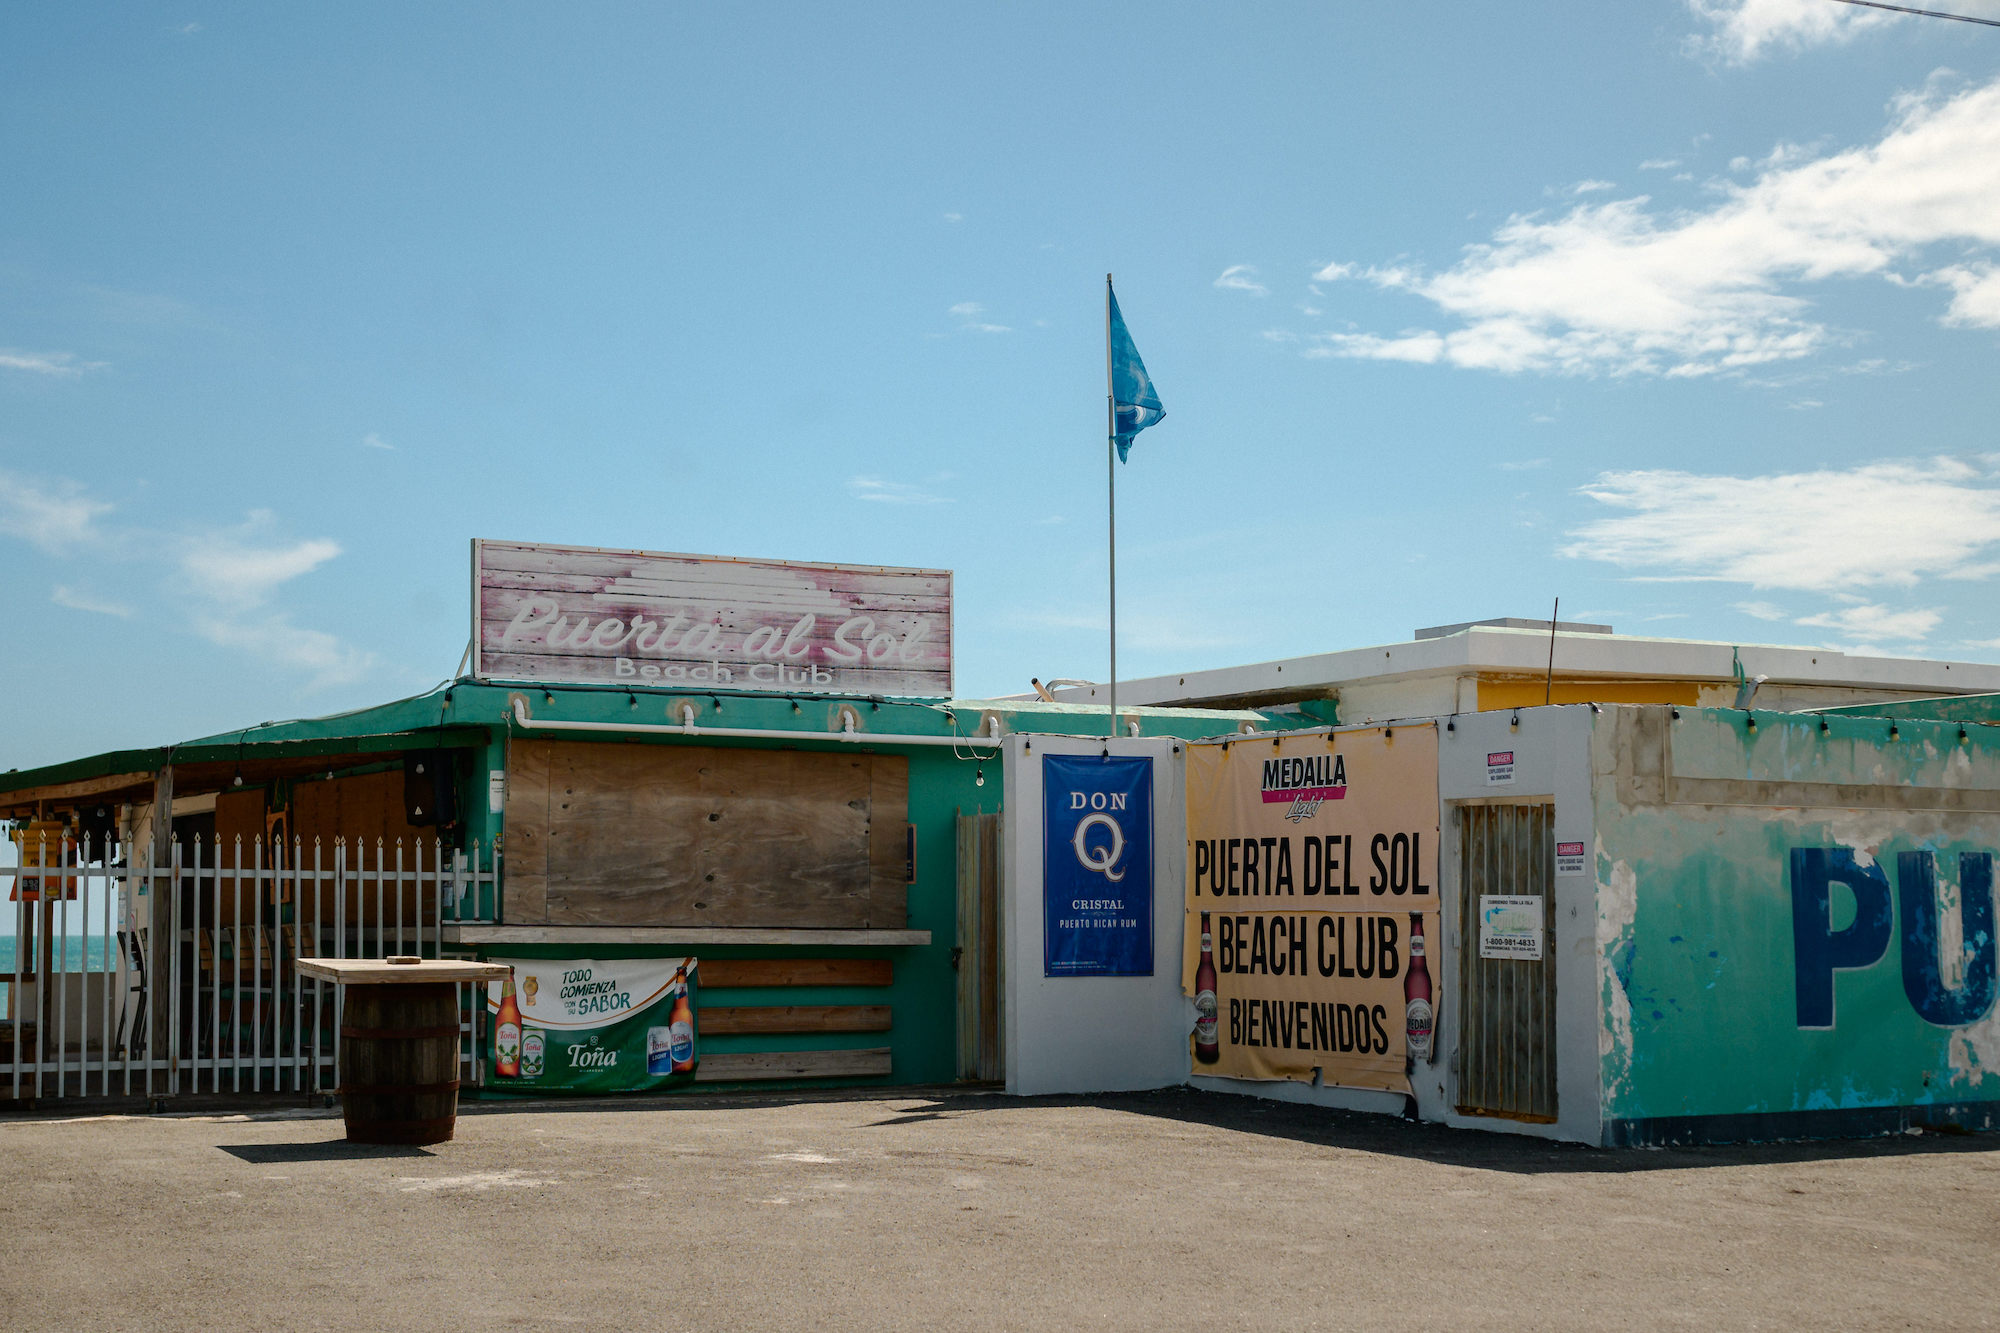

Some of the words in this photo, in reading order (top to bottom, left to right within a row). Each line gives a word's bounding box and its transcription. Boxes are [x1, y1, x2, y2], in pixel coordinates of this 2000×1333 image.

[500, 597, 726, 656] Puerta
[743, 613, 816, 657] al
[822, 615, 931, 664] Sol
[616, 657, 732, 682] Beach
[749, 662, 834, 685] Club
[1490, 754, 1511, 763] DANGER
[1261, 753, 1348, 791] MEDALLA
[1070, 792, 1128, 810] DON
[1285, 793, 1325, 824] Light
[1070, 812, 1127, 882] Q
[1559, 845, 1581, 853] DANGER
[1195, 837, 1295, 897] PUERTA
[1303, 835, 1360, 896] DEL
[1370, 832, 1430, 896] SOL
[1072, 900, 1124, 910] CRISTAL
[1060, 919, 1089, 929] PUERTO
[1093, 919, 1117, 928] RICAN
[1120, 919, 1137, 928] RUM
[1219, 916, 1308, 977] BEACH
[1317, 916, 1400, 979] CLUB
[1485, 938, 1536, 947] 1-800-981-4833
[1791, 847, 1998, 1029] PU
[562, 968, 592, 984] TODO
[560, 980, 616, 999] COMIENZA
[578, 992, 632, 1015] SABOR
[500, 1031, 517, 1040] Toña
[1230, 999, 1389, 1056] BIENVENIDOS
[524, 1042, 541, 1051] Toña
[567, 1043, 618, 1067] Toña
[650, 1040, 668, 1051] Toña
[652, 1053, 667, 1061] LIGHT
